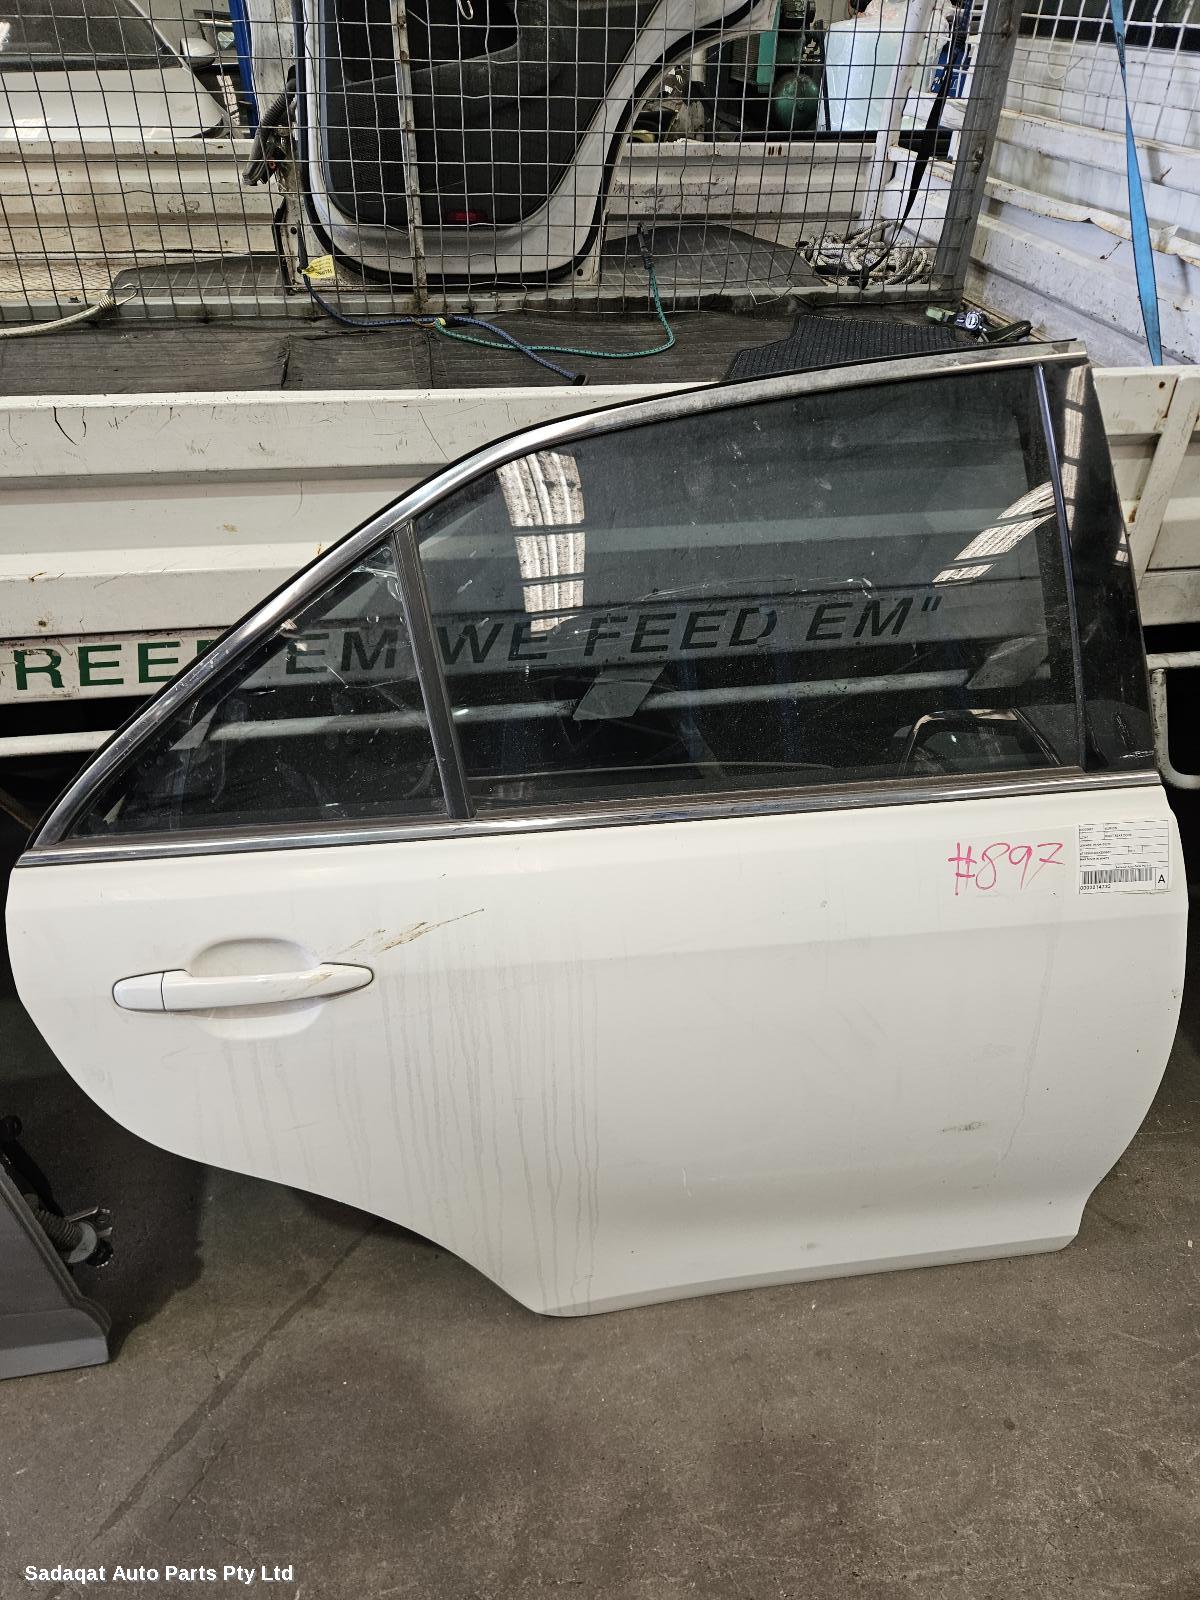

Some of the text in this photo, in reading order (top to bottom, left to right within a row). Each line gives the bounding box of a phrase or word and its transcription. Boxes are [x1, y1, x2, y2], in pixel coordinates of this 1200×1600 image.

[13, 638, 216, 690] REE
[436, 614, 548, 664] WE
[584, 605, 777, 657] FEED
[948, 841, 1065, 896] #897
[1157, 873, 1166, 884] A
